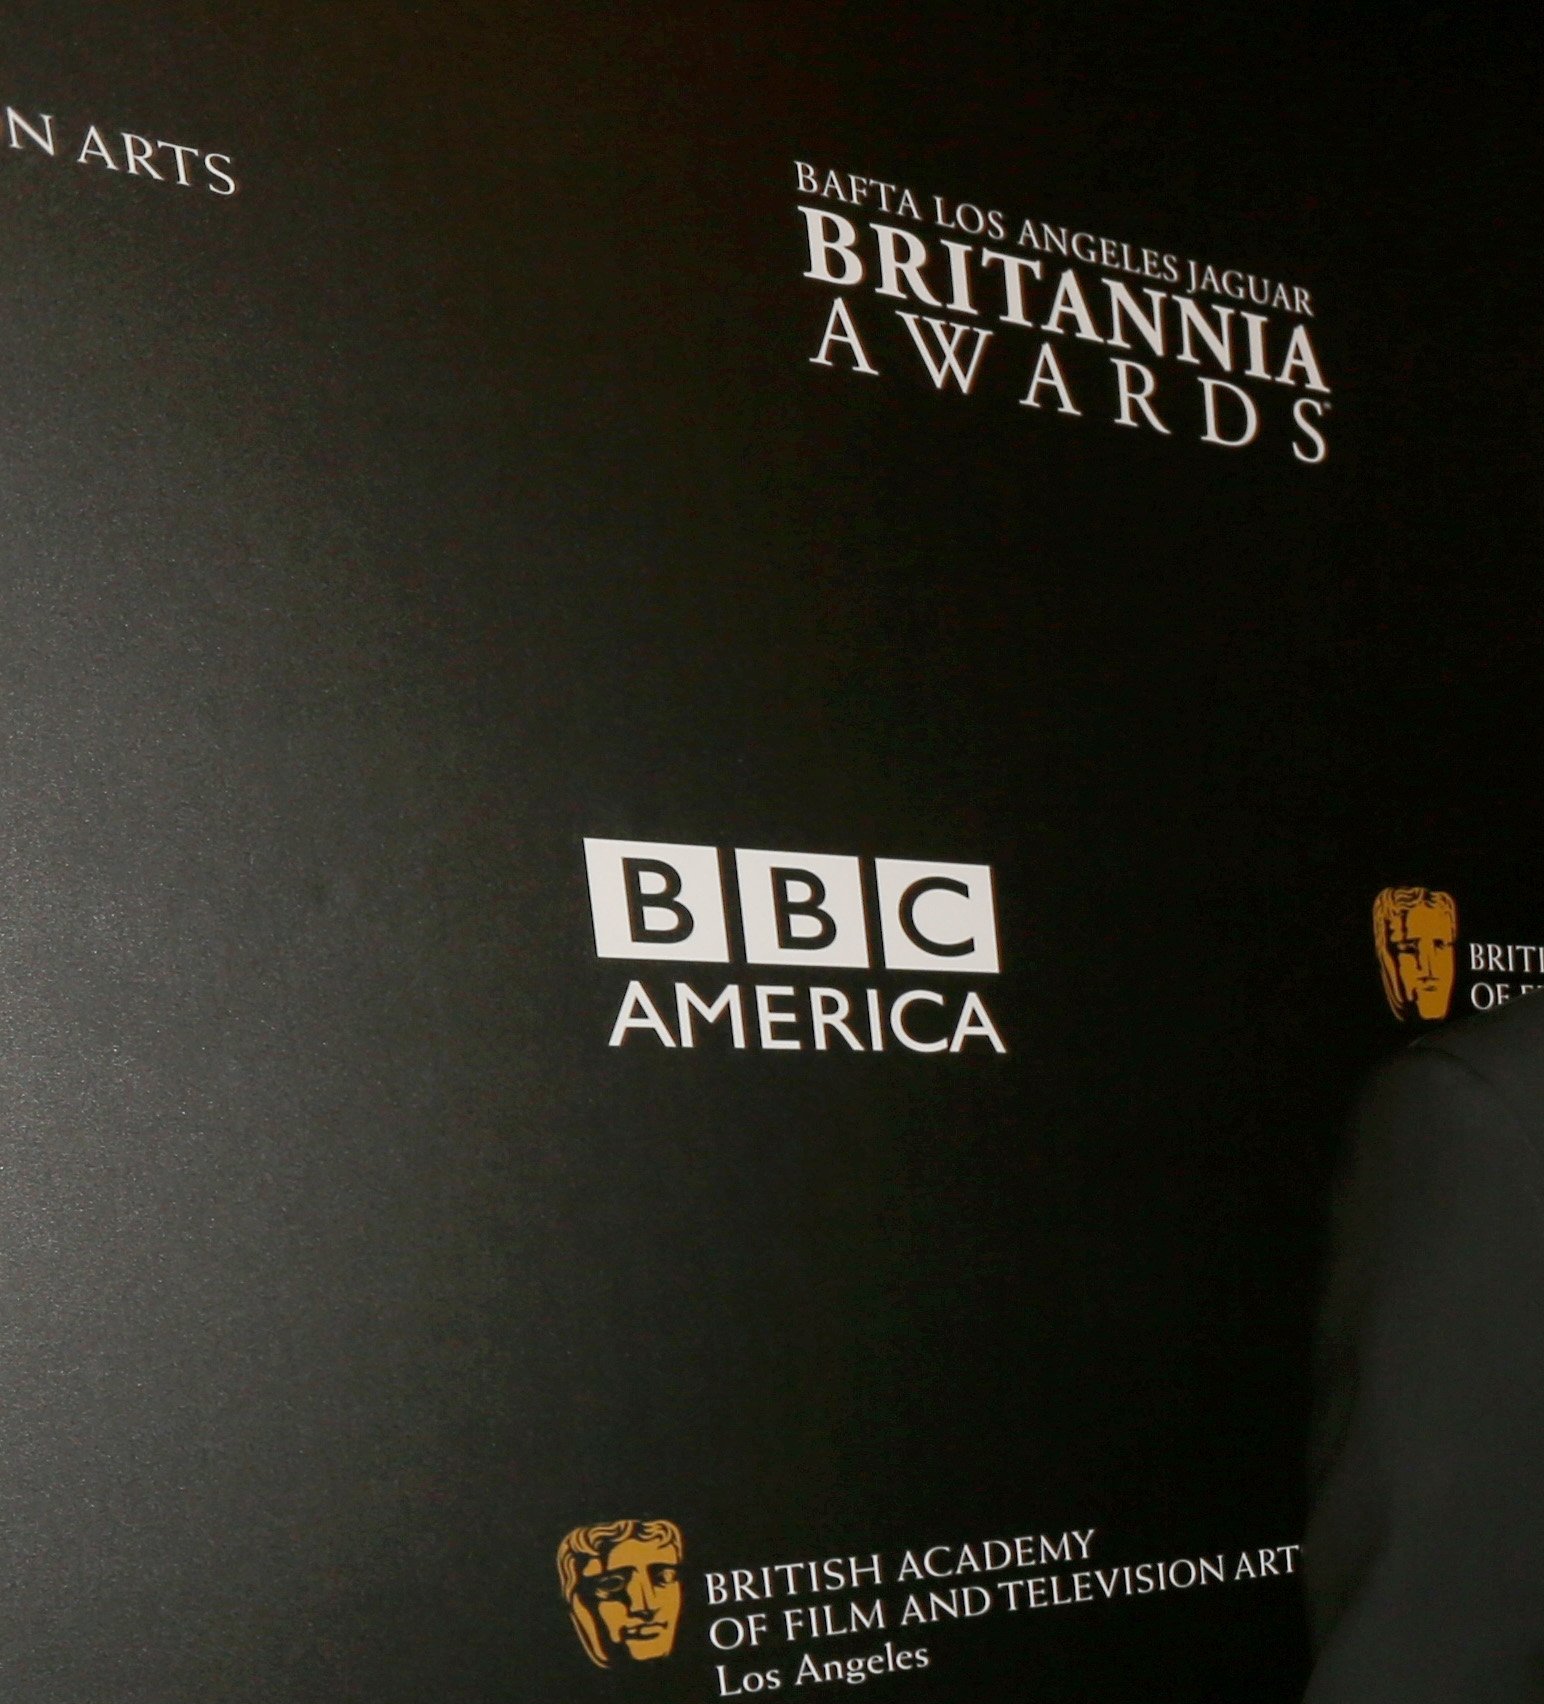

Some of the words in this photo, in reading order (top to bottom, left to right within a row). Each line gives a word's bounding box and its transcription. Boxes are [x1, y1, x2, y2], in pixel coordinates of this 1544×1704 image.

[77, 125, 236, 195] ARTS
[794, 160, 921, 220] BAFTA
[934, 195, 1005, 240] LOS
[1018, 219, 1179, 282] ANGELES
[1186, 259, 1313, 316] JAGUAR
[797, 205, 1331, 394] BRITANNIA
[808, 296, 1326, 464] AWARDS
[622, 857, 976, 958] BBC
[608, 979, 1007, 1054] AMERICA
[1470, 982, 1510, 1010] OF
[705, 1554, 882, 1605] BRITISH
[897, 1528, 1095, 1582] ACADEMY
[709, 1613, 767, 1650] OF
[783, 1598, 885, 1641] FILM
[900, 1586, 991, 1626] AND
[997, 1554, 1224, 1611] TELEVISION
[1234, 1544, 1300, 1581] ART
[716, 1664, 781, 1697] Los
[795, 1641, 929, 1686] Angeles
